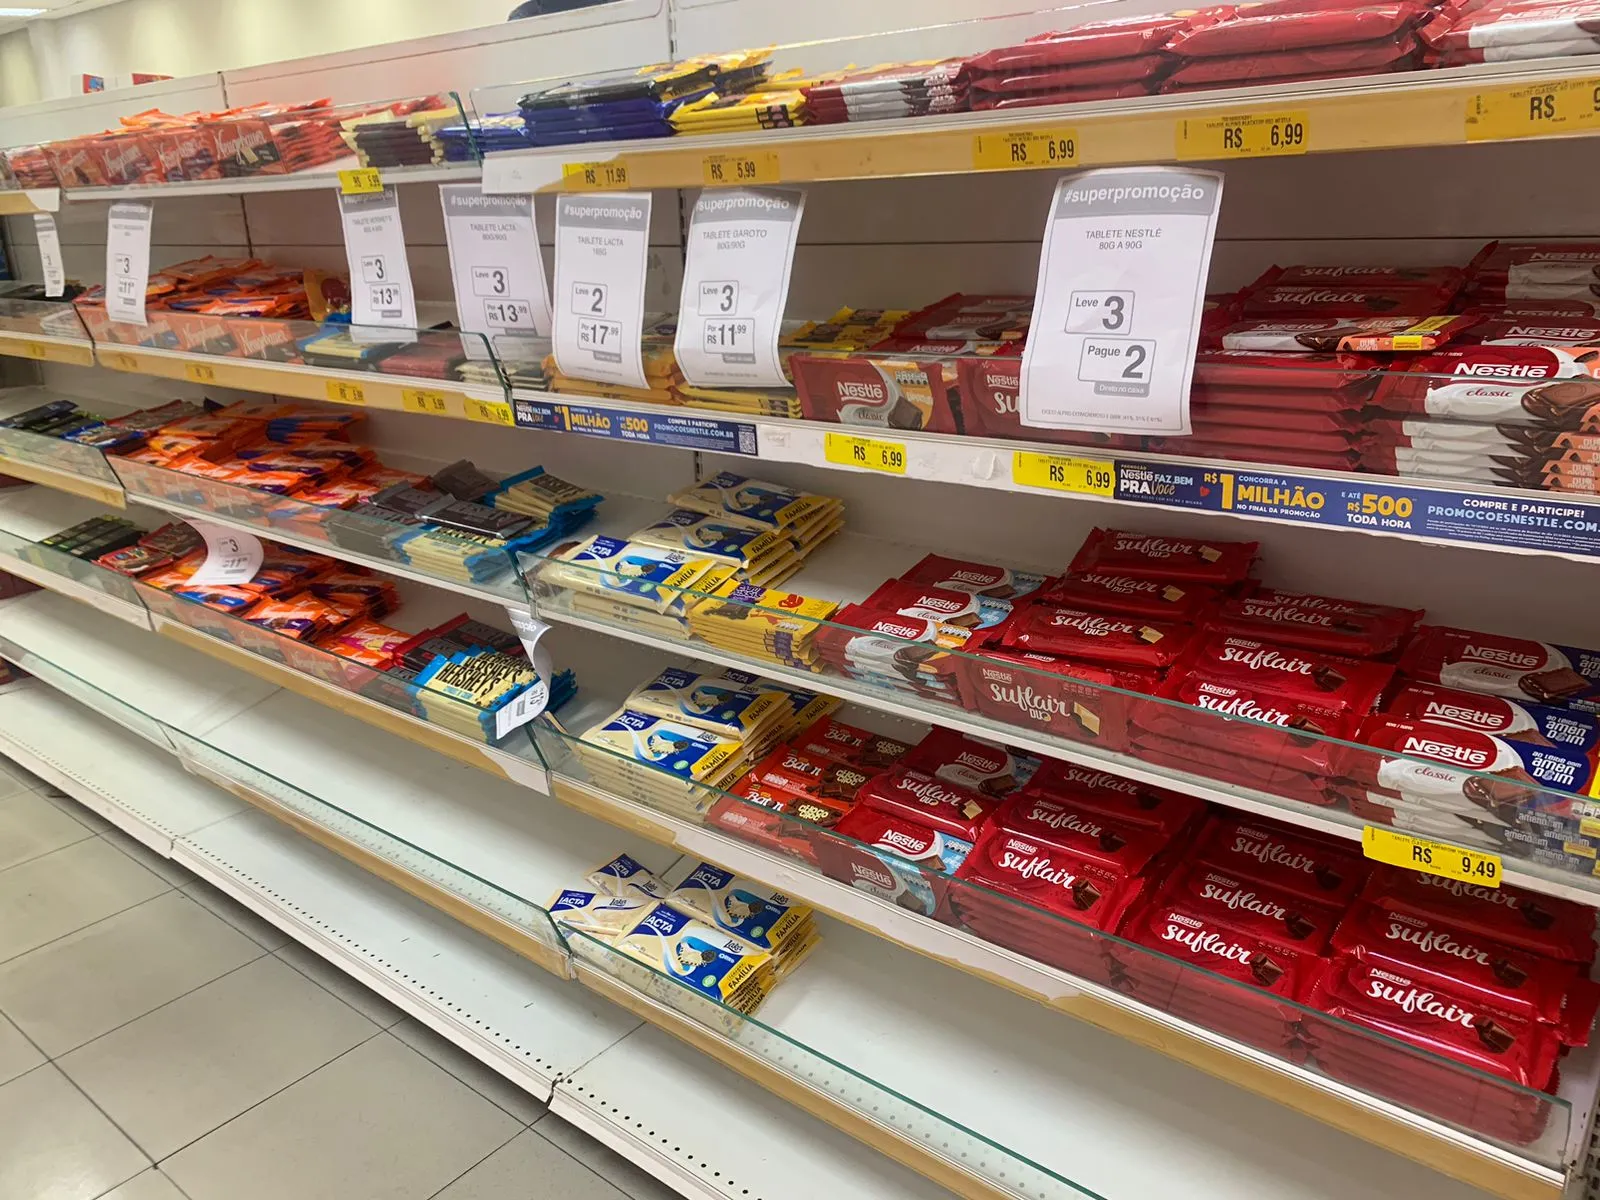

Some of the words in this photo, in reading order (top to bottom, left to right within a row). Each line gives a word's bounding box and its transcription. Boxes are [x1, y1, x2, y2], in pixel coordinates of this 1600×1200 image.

[1529, 94, 1555, 121] R$
[1223, 127, 1243, 149] R$
[1270, 122, 1303, 149] 6,99
[1011, 143, 1027, 162] R$
[1048, 139, 1075, 162] 6,99
[710, 163, 723, 179] R$
[737, 160, 756, 179] 5,99
[1064, 183, 1205, 204] #superpromoção
[703, 230, 731, 239] TABLETE
[732, 229, 768, 239] GAROTO
[1086, 230, 1123, 239] TABLETE
[1124, 228, 1162, 238] NESTLÉ
[1098, 241, 1116, 250] 80G
[1116, 241, 1124, 249] A
[1124, 240, 1143, 249] 90G
[374, 258, 384, 279] 3
[492, 270, 506, 294] 3
[591, 287, 604, 313] 2
[702, 286, 718, 295] Leve
[720, 284, 734, 312] 3
[1075, 297, 1099, 307] Leve
[1102, 295, 1125, 330] 3
[1087, 345, 1121, 359] Pague
[1122, 344, 1146, 379] 2
[1453, 362, 1549, 378] Nestlé
[837, 381, 883, 399] Nestlé
[1466, 386, 1513, 398] classic
[517, 412, 533, 422] PRA
[571, 413, 611, 429] MILHÃO
[625, 416, 649, 433] 500
[853, 445, 866, 461] R$
[881, 450, 902, 467] 6,99
[1049, 464, 1065, 483] R$
[1086, 469, 1111, 489] 6,99
[1120, 469, 1154, 482] Nestlé
[1154, 473, 1172, 484] FAZ
[1174, 475, 1194, 486] BEM
[1120, 479, 1151, 495] PRA
[1238, 475, 1279, 486] CONCORRA
[1203, 472, 1218, 485] R$
[1219, 472, 1235, 511] 1
[1237, 484, 1326, 511] MILHÃO
[1236, 503, 1248, 511] NO
[1248, 504, 1268, 513] FINAL
[1280, 507, 1321, 520] PROMOÇÃO
[1347, 491, 1361, 499] ATÉ
[1362, 493, 1414, 518] 500
[1347, 502, 1360, 513] R$
[1463, 498, 1509, 511] COMPRE
[1511, 503, 1518, 512] E
[1521, 504, 1586, 519] PARTICIPE!
[1346, 513, 1378, 526] TODA
[1380, 518, 1412, 530] HORA
[228, 538, 239, 553] 3
[1113, 538, 1194, 556] suflair
[953, 569, 996, 584] Nestlé
[916, 595, 962, 612] Nestlé
[1050, 614, 1134, 635] suflair
[1241, 604, 1333, 627] suflair
[872, 621, 921, 638] Nestlé
[1219, 646, 1314, 676] suflair
[1463, 644, 1540, 666] Nestlé
[989, 683, 1071, 718] suflair
[1192, 694, 1293, 728] suflair
[1425, 701, 1506, 726] Nestlé
[1403, 736, 1489, 764] Nestlé
[958, 751, 1000, 772] Nestlé
[1531, 756, 1576, 775] amen
[1063, 768, 1141, 796] suflair
[1414, 766, 1457, 782] classic
[896, 777, 962, 807] suflair
[1026, 807, 1103, 838] suflair
[882, 829, 928, 852] Nestlé
[1005, 838, 1039, 854] Nestlé
[1230, 836, 1315, 874] suflair
[1411, 845, 1432, 865] R$
[1461, 856, 1496, 878] 9,49
[997, 852, 1077, 890] suflair
[1199, 883, 1287, 921] suflair
[1160, 923, 1251, 966] suflair
[1384, 922, 1491, 966] suflair
[1365, 979, 1477, 1029] suflair
